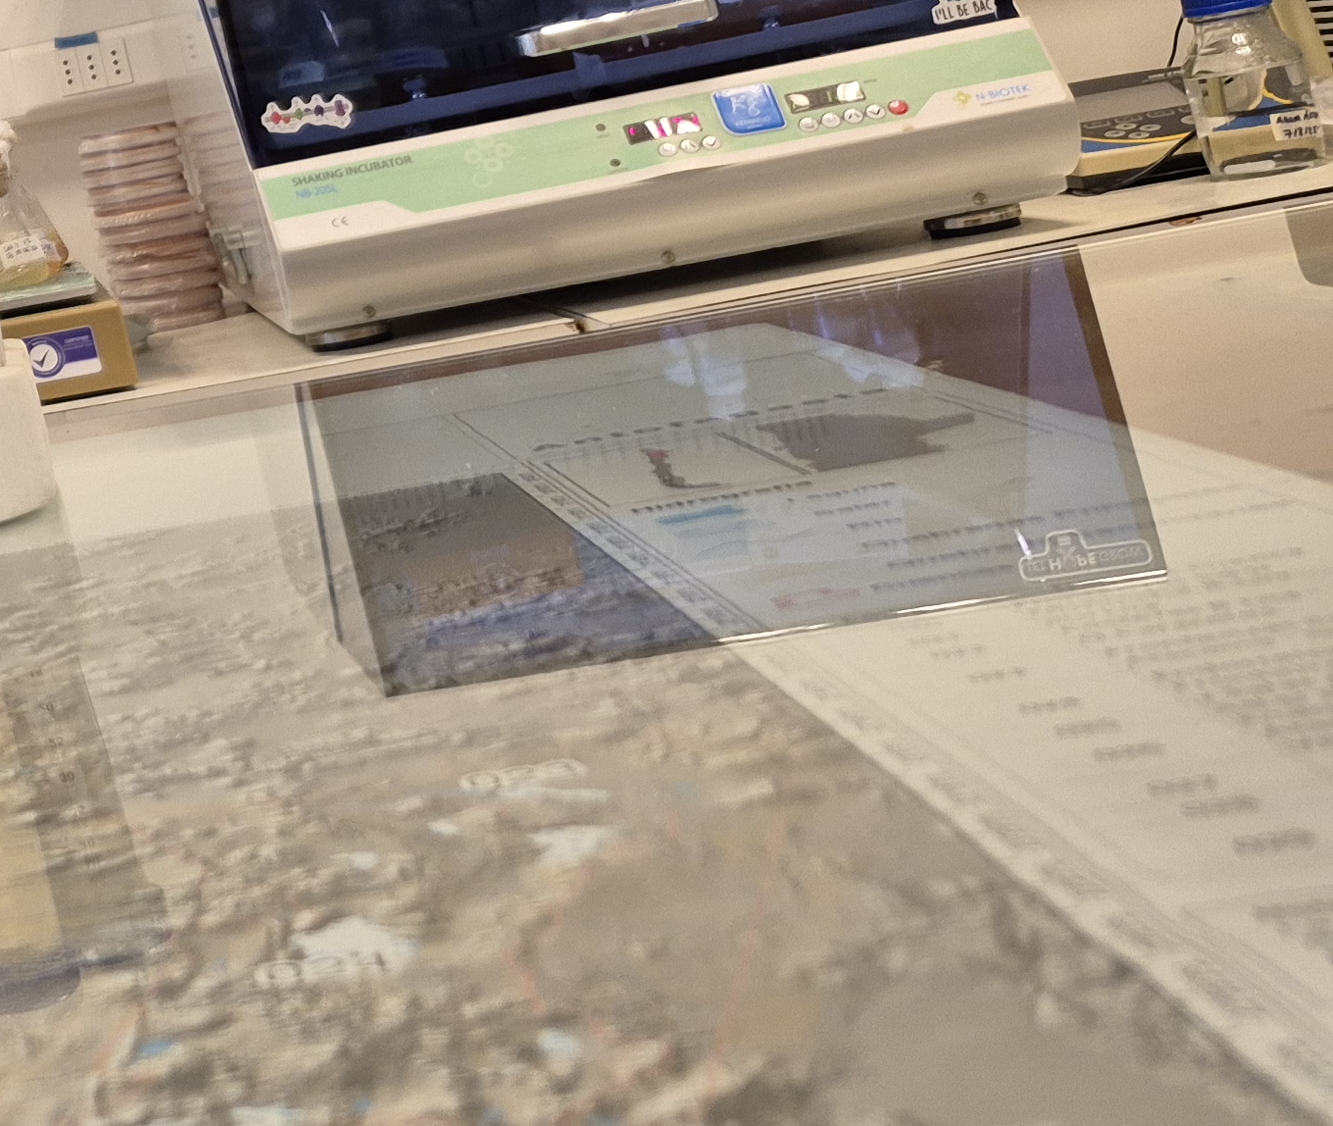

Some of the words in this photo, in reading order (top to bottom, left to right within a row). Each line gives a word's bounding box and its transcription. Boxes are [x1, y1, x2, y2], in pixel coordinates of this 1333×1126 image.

[935, 9, 955, 21] I'LL
[956, 4, 970, 17] BE
[976, 83, 1031, 101] N-BIOTEK
[291, 168, 344, 186] SHAKING
[345, 155, 413, 176] INCUBATOR
[331, 216, 349, 228] CE
